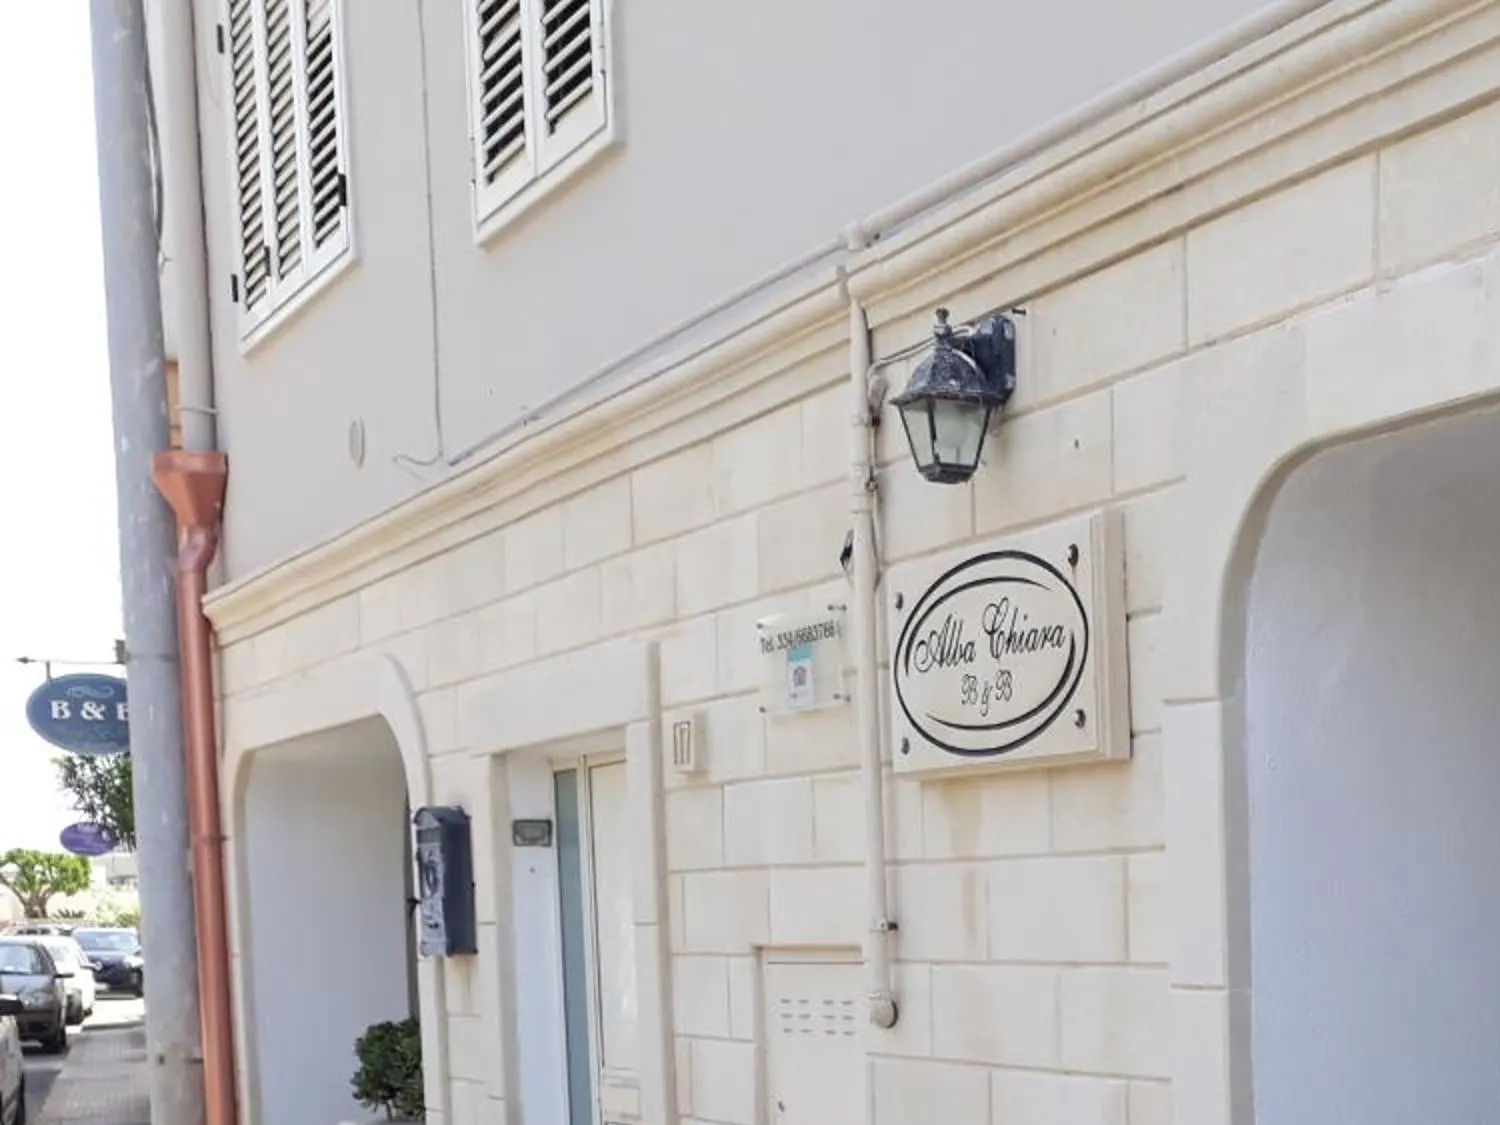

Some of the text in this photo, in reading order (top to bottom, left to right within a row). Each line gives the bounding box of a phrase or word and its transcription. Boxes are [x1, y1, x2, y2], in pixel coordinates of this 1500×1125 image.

[914, 596, 1066, 673] Alba Chiara
[961, 673, 979, 705] B
[995, 669, 1013, 702] B
[51, 700, 71, 719] B
[81, 701, 106, 720] &
